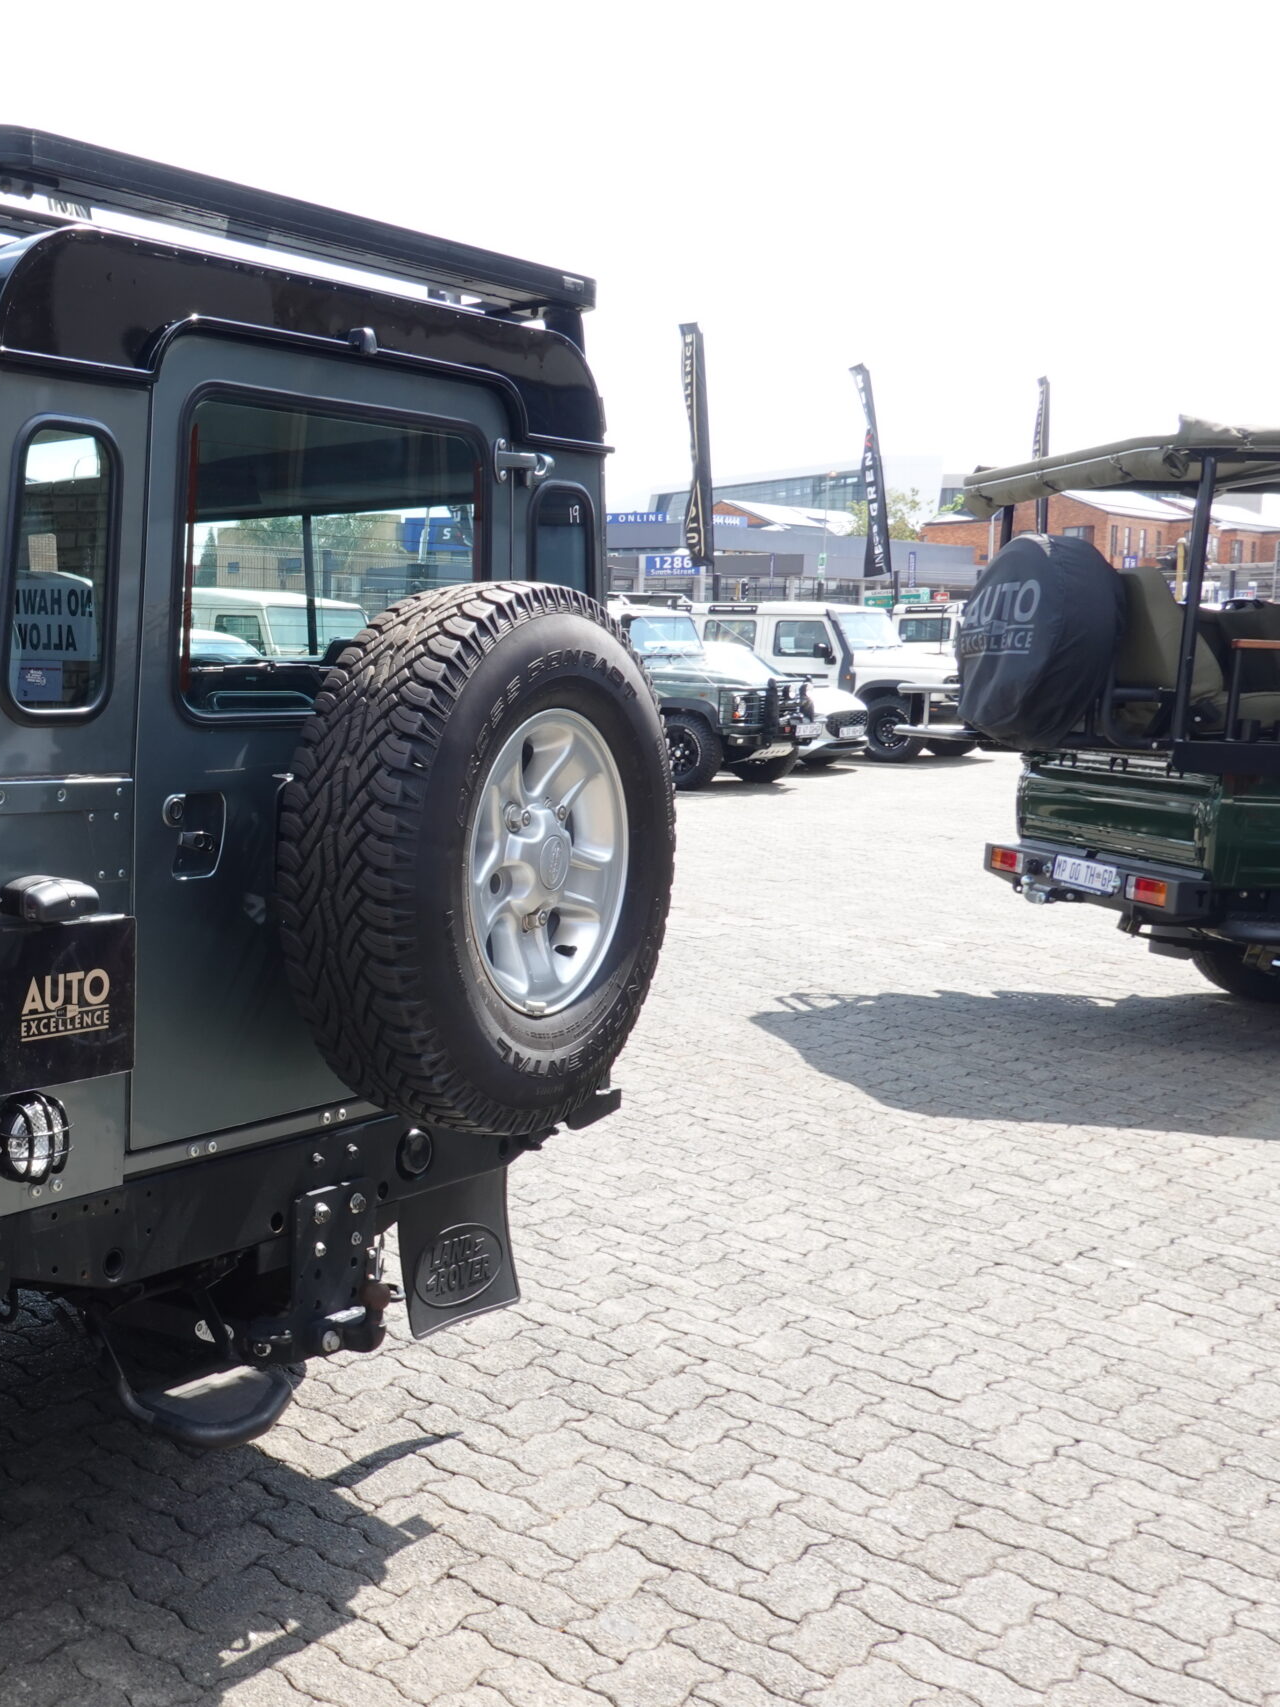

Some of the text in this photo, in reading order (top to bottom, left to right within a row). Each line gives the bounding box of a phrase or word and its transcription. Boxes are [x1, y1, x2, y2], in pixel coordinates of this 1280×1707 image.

[654, 556, 692, 569] 1286
[960, 578, 1041, 629] AUTO
[21, 967, 110, 1015] AUTO
[21, 1009, 110, 1037] EXCELLENCE
[429, 1233, 471, 1273] LAND
[434, 1255, 490, 1297] ROVER
